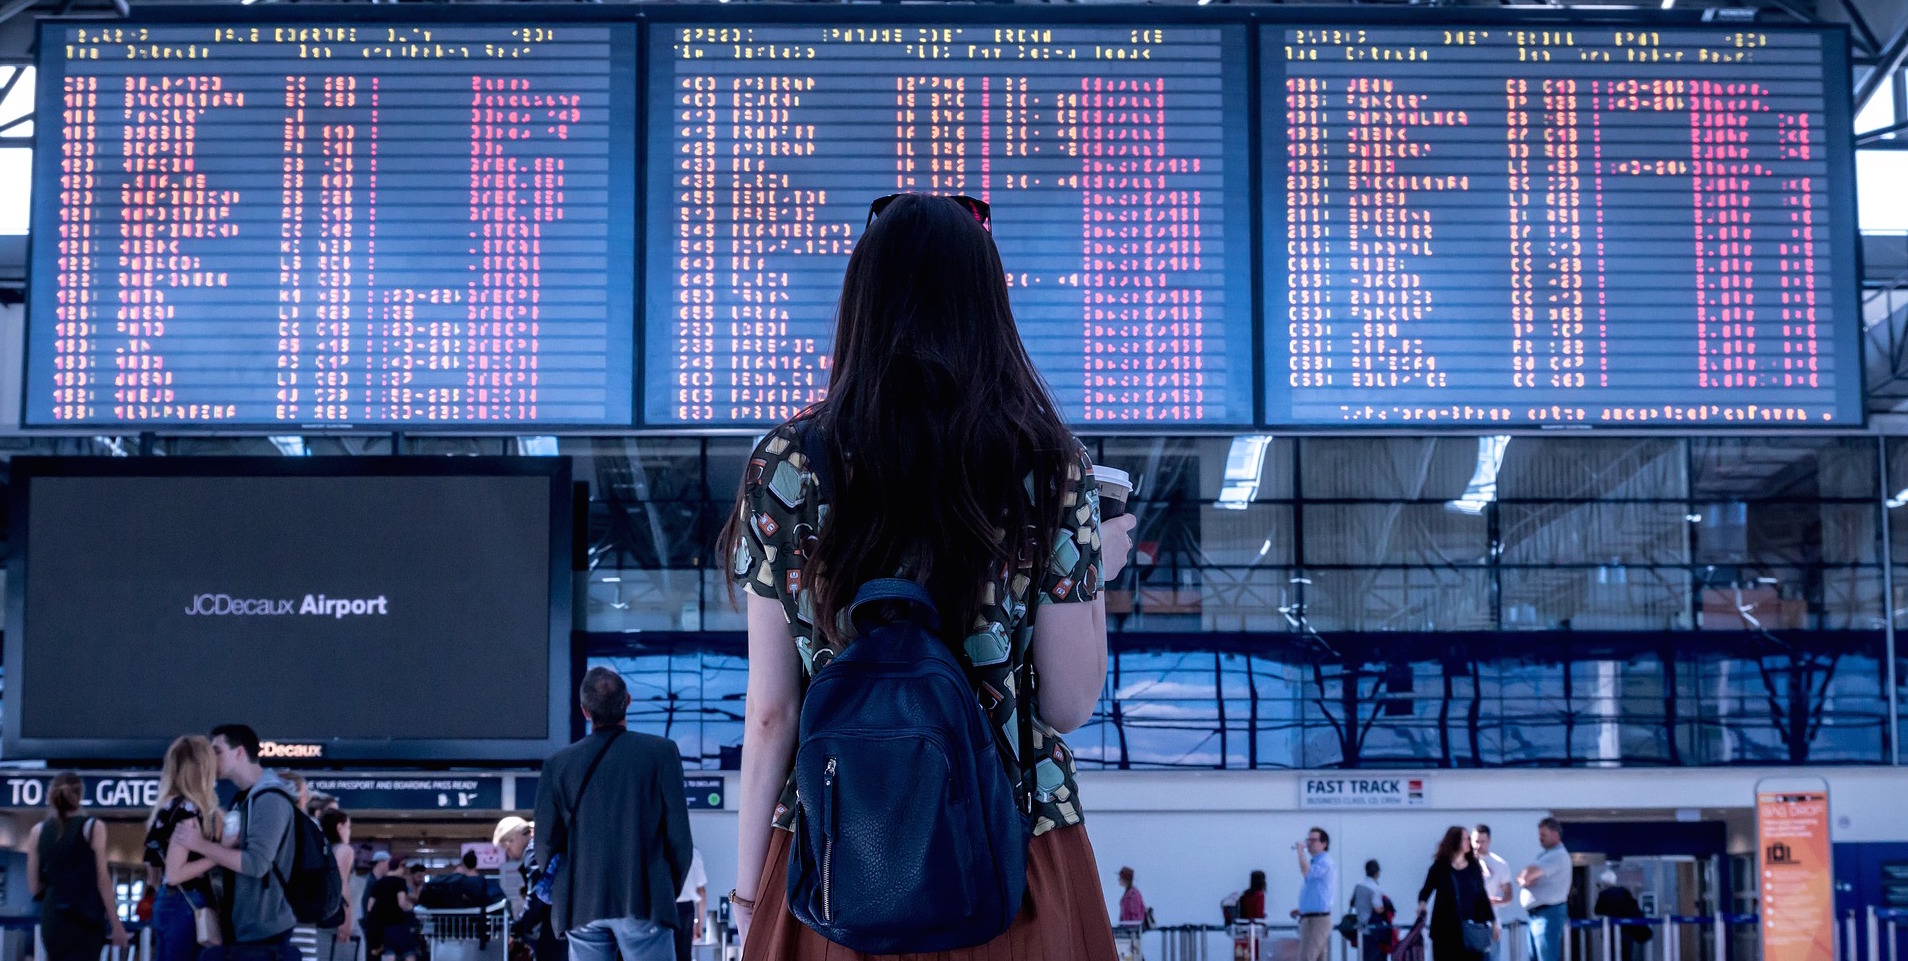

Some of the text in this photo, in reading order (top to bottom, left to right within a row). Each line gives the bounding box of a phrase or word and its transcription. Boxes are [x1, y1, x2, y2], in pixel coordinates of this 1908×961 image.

[185, 594, 388, 619] JCDecaux Airport
[7, 779, 43, 806] TO
[315, 780, 336, 790] YOUR
[337, 780, 375, 790] PASSPORT
[376, 780, 393, 790] AND
[393, 780, 432, 790] BOARDING
[433, 780, 451, 790] PASS
[452, 780, 478, 790] READY
[1307, 780, 1400, 794] FAST TRACK
